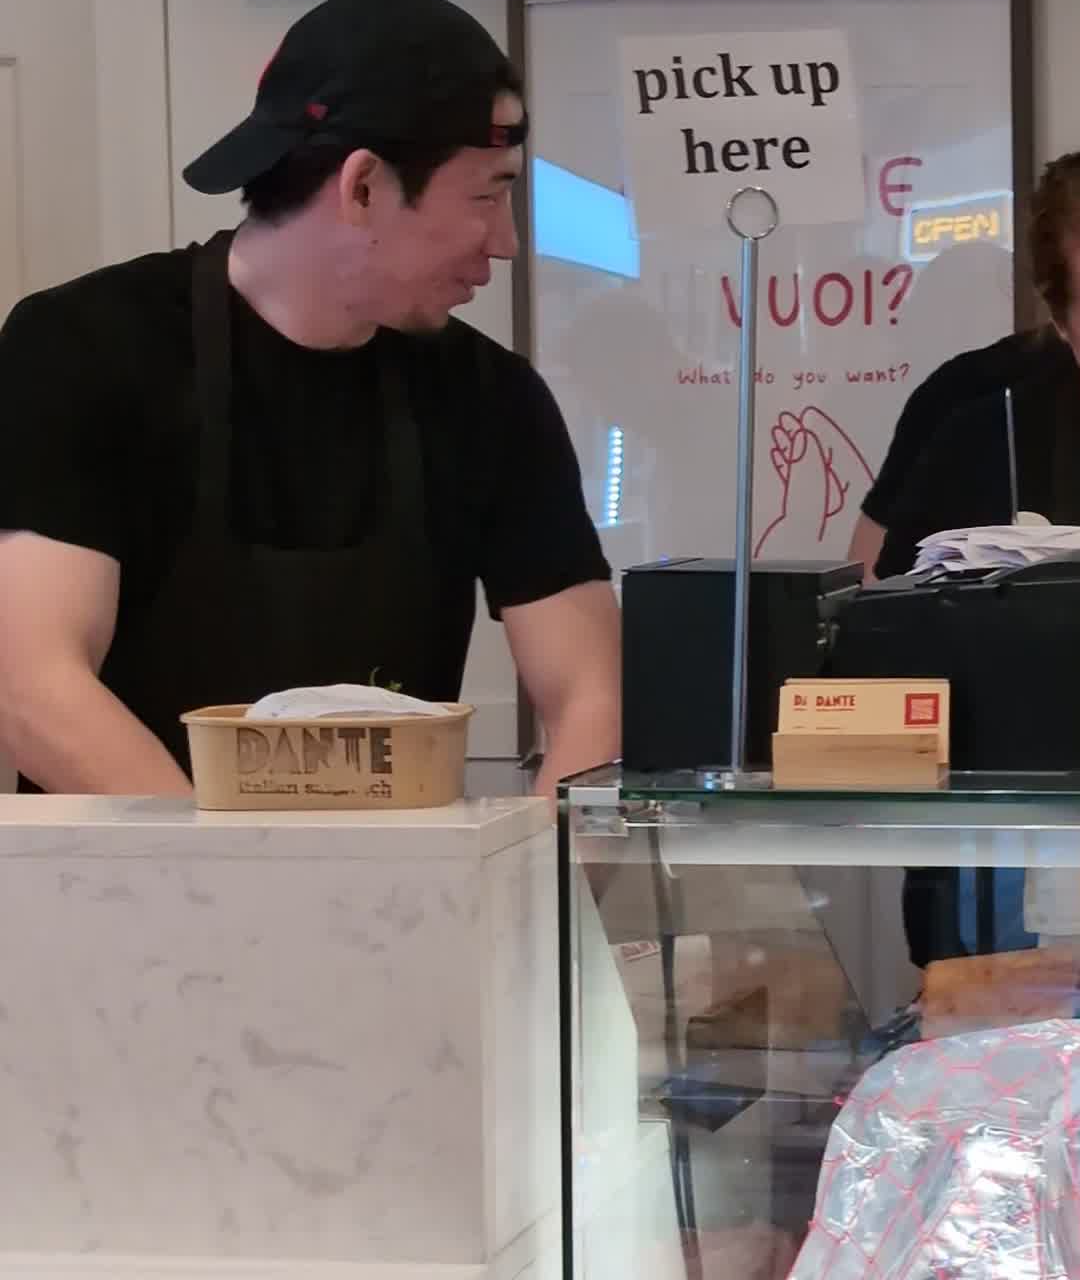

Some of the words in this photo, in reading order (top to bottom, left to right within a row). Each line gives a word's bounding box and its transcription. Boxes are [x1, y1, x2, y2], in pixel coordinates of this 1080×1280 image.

[634, 53, 757, 114] pick
[771, 59, 840, 106] up
[681, 129, 810, 174] here
[678, 366, 732, 386] What
[793, 370, 828, 392] you
[846, 363, 911, 384] want?
[815, 694, 856, 707] DANTE
[236, 727, 392, 775] DANTE
